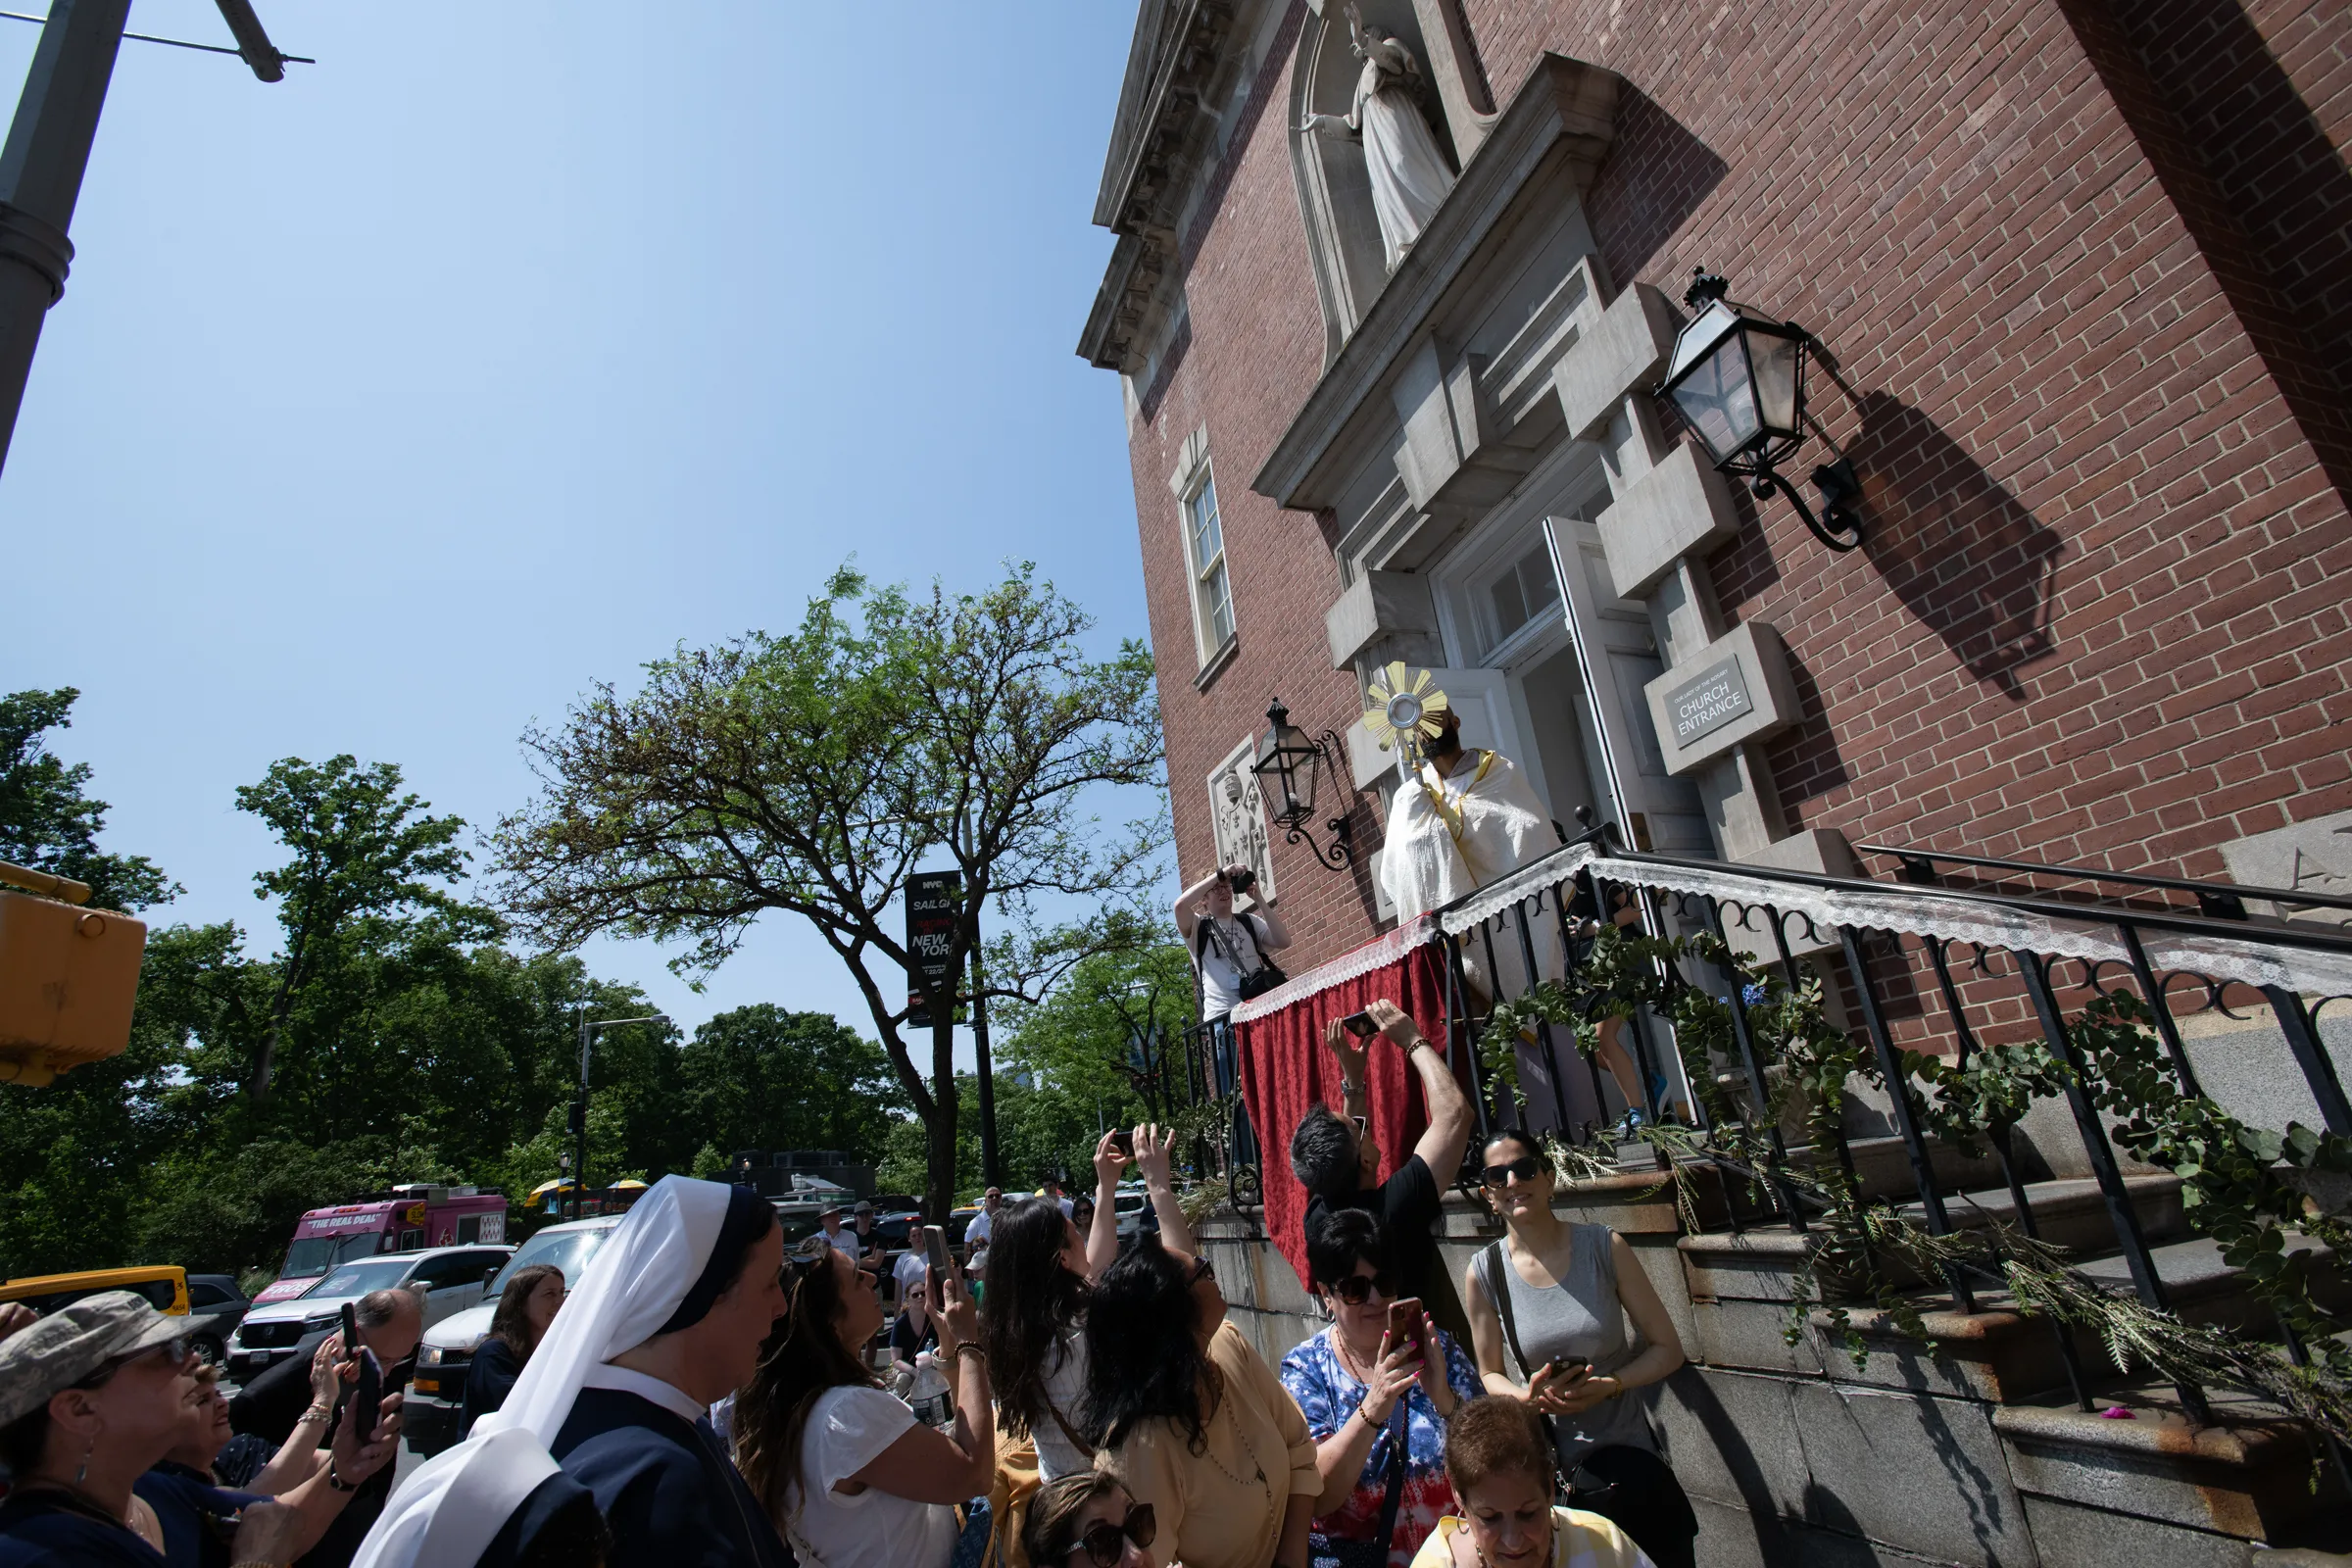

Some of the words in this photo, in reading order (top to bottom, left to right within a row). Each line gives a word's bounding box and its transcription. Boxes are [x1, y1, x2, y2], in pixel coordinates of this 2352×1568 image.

[1674, 695, 1685, 705] OUR
[1684, 688, 1694, 699] LADY
[1710, 668, 1728, 682] ROSARY
[1680, 681, 1730, 718] CHURCH
[1678, 691, 1742, 736] ENTRANCE
[922, 880, 943, 890] NYC
[911, 933, 947, 948] NEW
[920, 943, 953, 957] YOR
[328, 1216, 353, 1227] REAL
